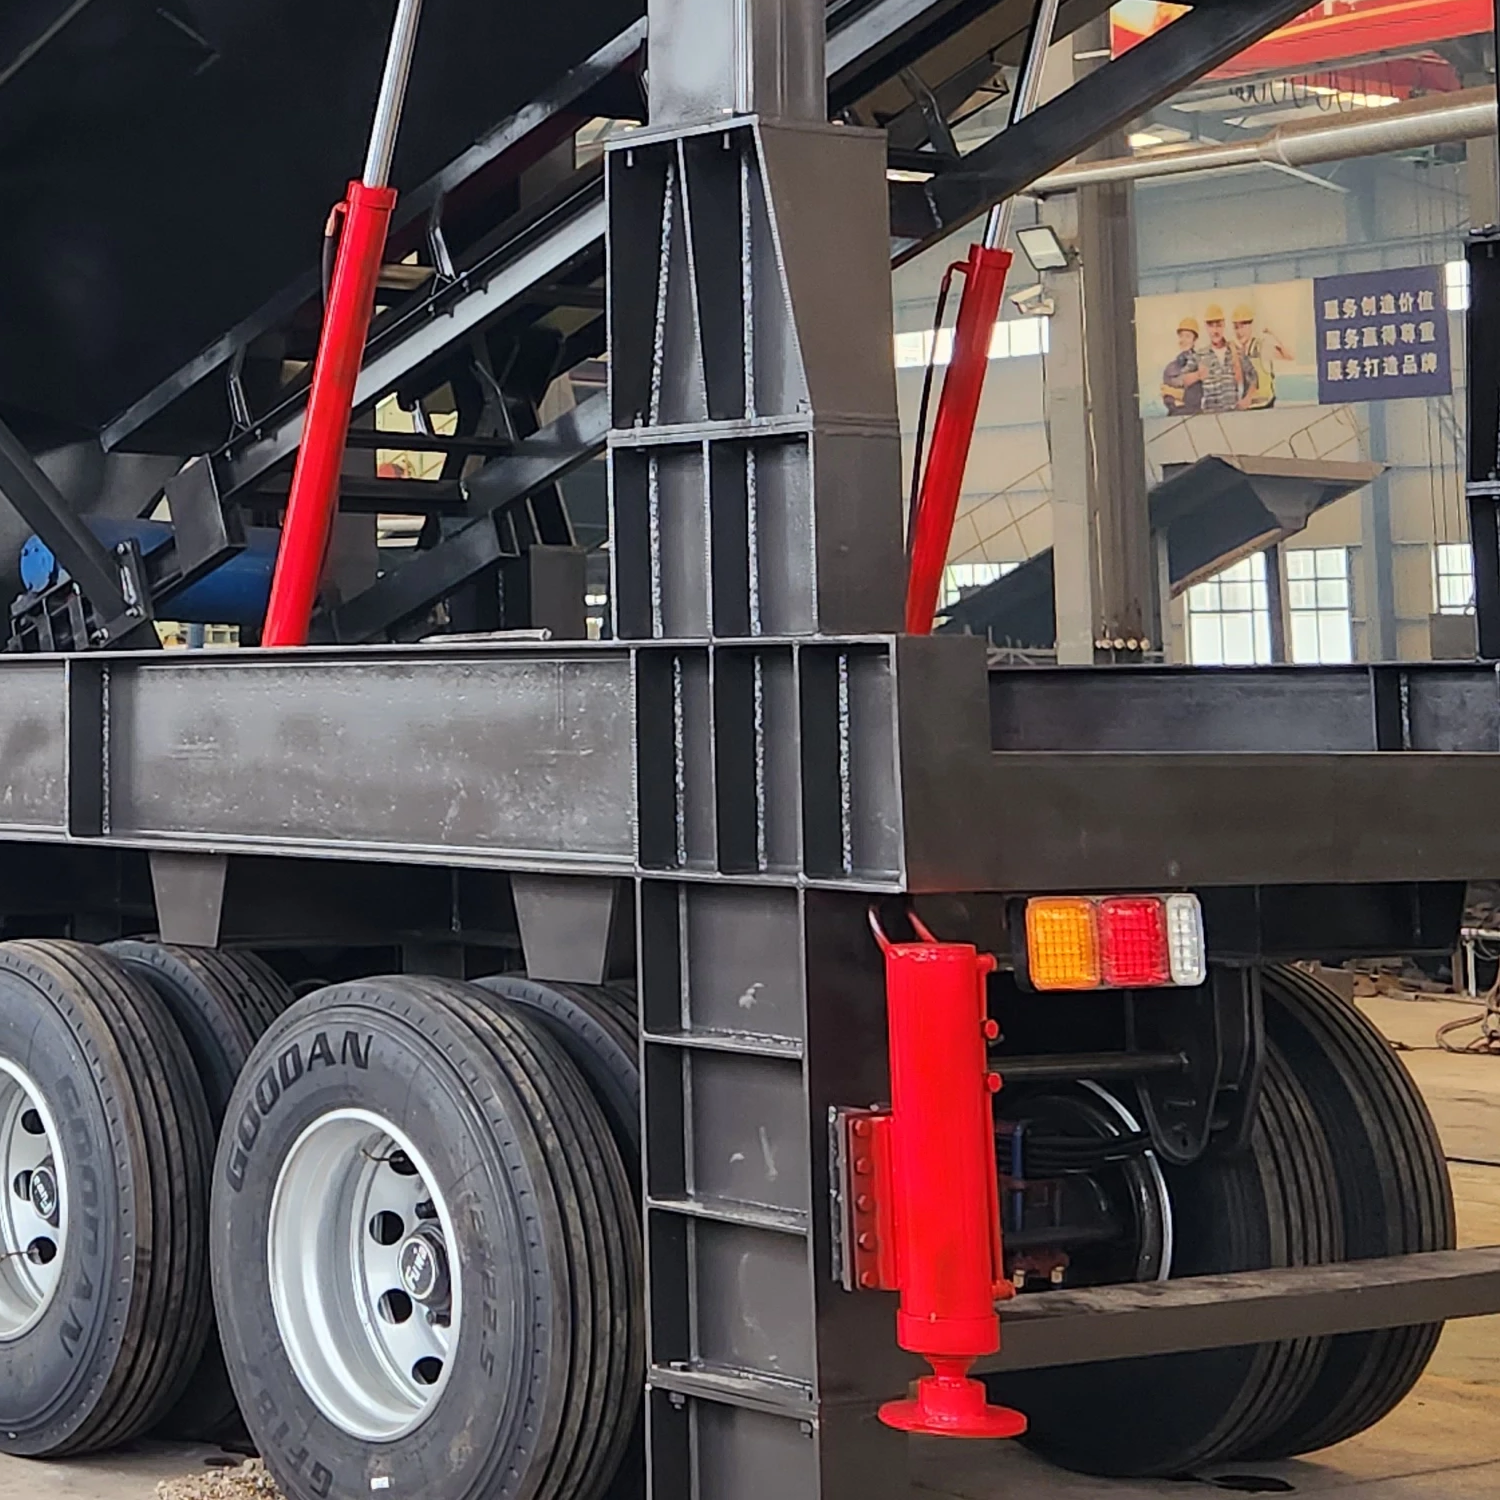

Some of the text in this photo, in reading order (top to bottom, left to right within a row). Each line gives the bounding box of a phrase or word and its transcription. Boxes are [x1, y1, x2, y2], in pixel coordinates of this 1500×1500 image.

[1324, 291, 1435, 319] 服务创造价值
[1328, 352, 1437, 380] 服务打造品牌
[226, 1031, 373, 1192] GOODAN
